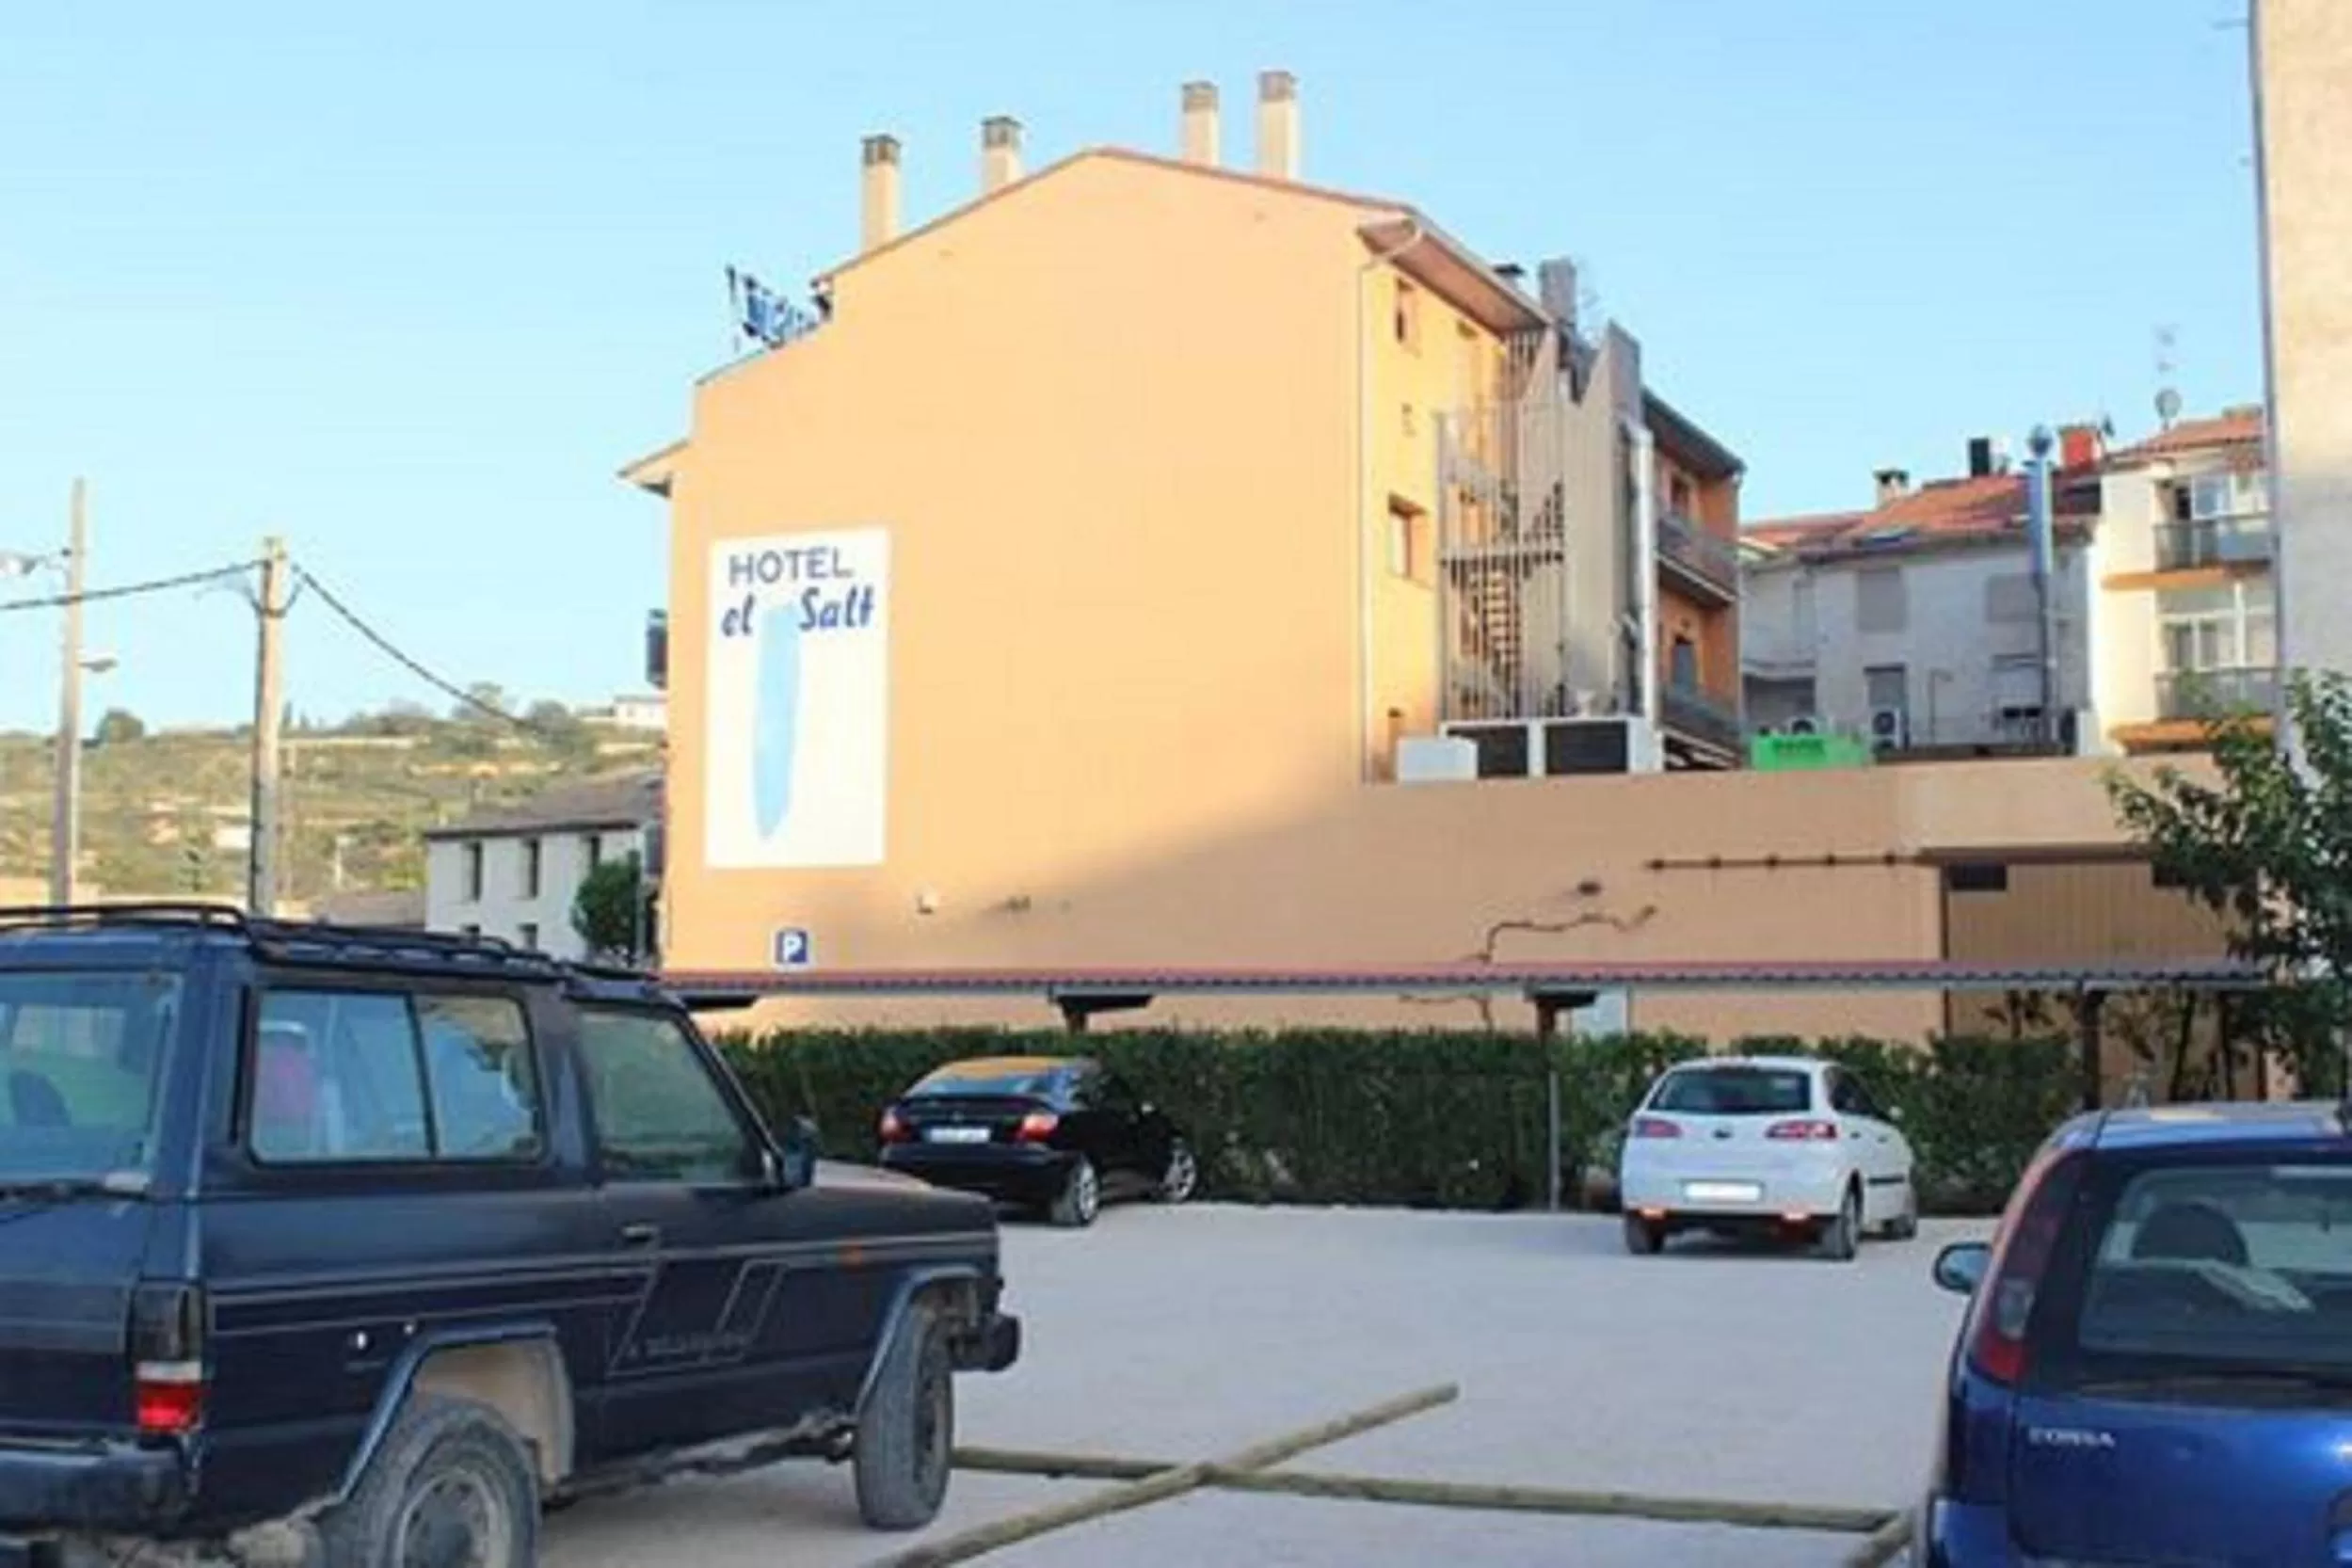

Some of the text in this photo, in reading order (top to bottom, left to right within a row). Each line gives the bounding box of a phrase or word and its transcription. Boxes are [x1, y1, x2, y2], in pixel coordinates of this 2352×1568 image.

[728, 546, 854, 585] HOTEL
[721, 584, 875, 637] el Salt
[782, 935, 802, 961] P
